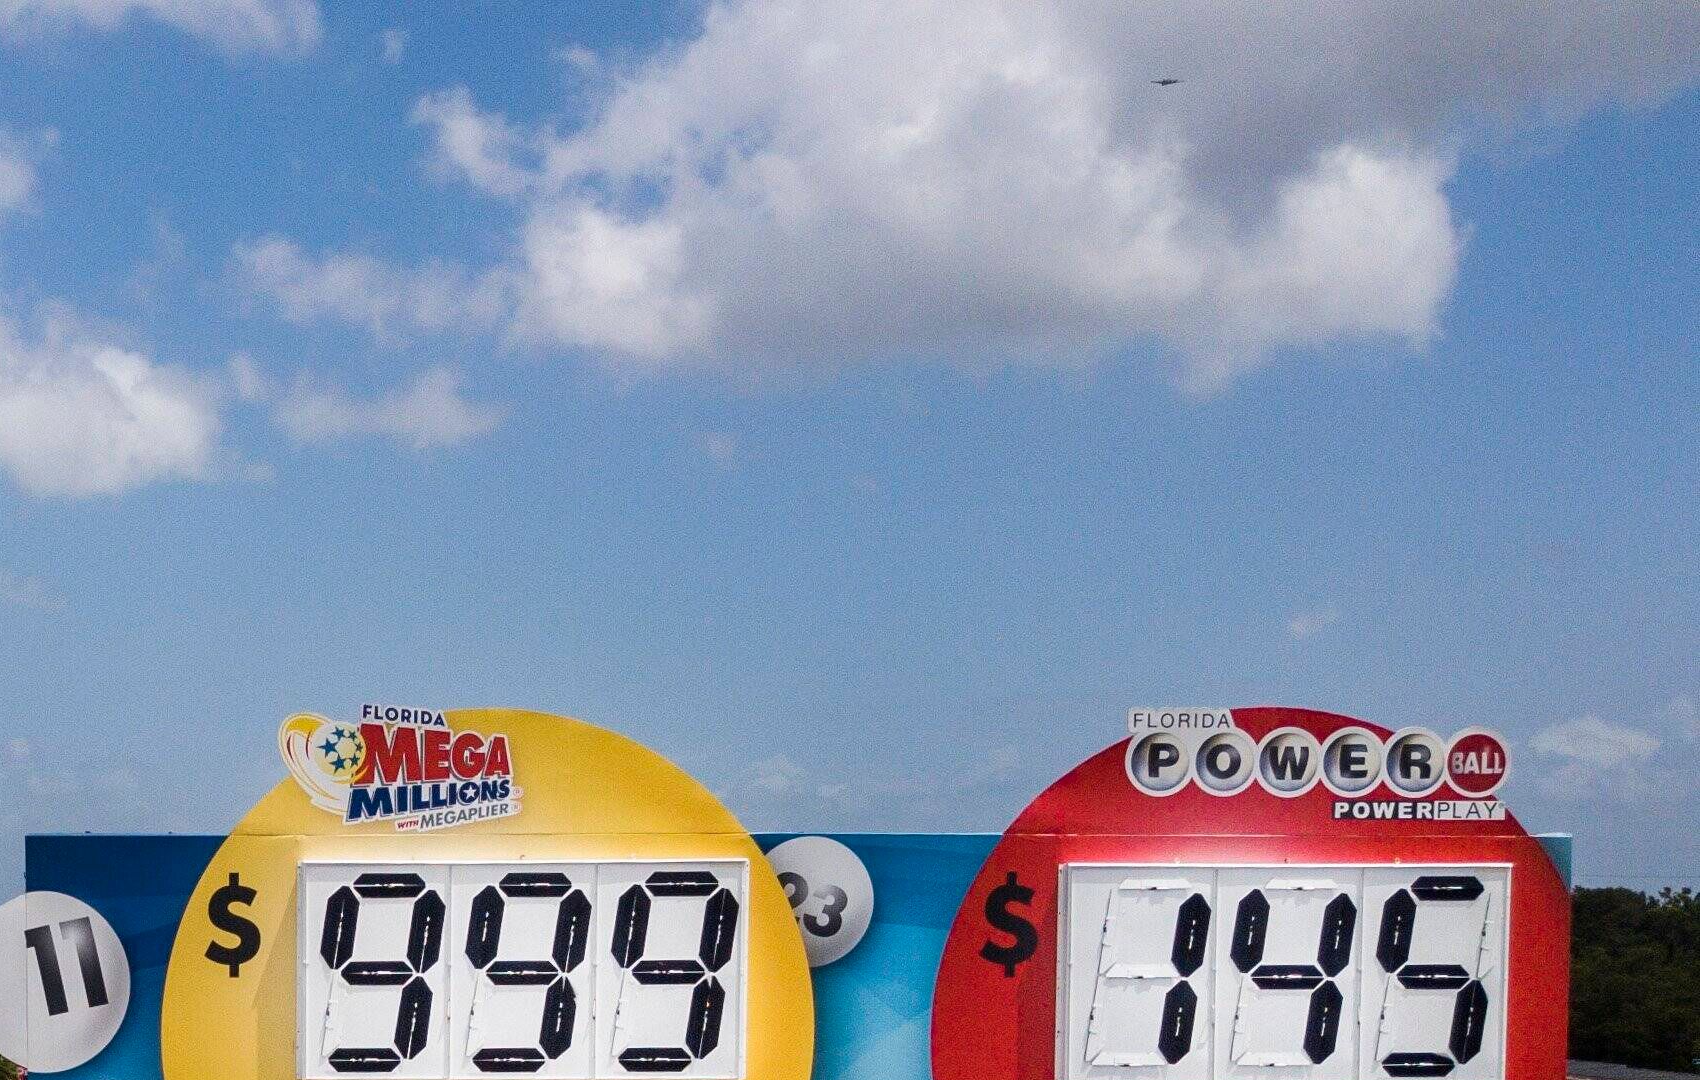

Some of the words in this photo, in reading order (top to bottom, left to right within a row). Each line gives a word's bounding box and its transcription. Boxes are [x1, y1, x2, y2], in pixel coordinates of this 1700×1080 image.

[362, 704, 446, 727] FLORIDA
[1132, 712, 1231, 729] FLORIDA
[351, 722, 511, 787] MEGA
[1147, 741, 1433, 781] POWER
[1451, 750, 1504, 775] BALL
[346, 778, 511, 823] MILLIONS
[396, 818, 419, 830] WITH
[419, 802, 509, 830] MEGAPLIER
[24, 916, 109, 1017] 11
[320, 871, 740, 1073] 999
[1157, 875, 1489, 1077] 145
